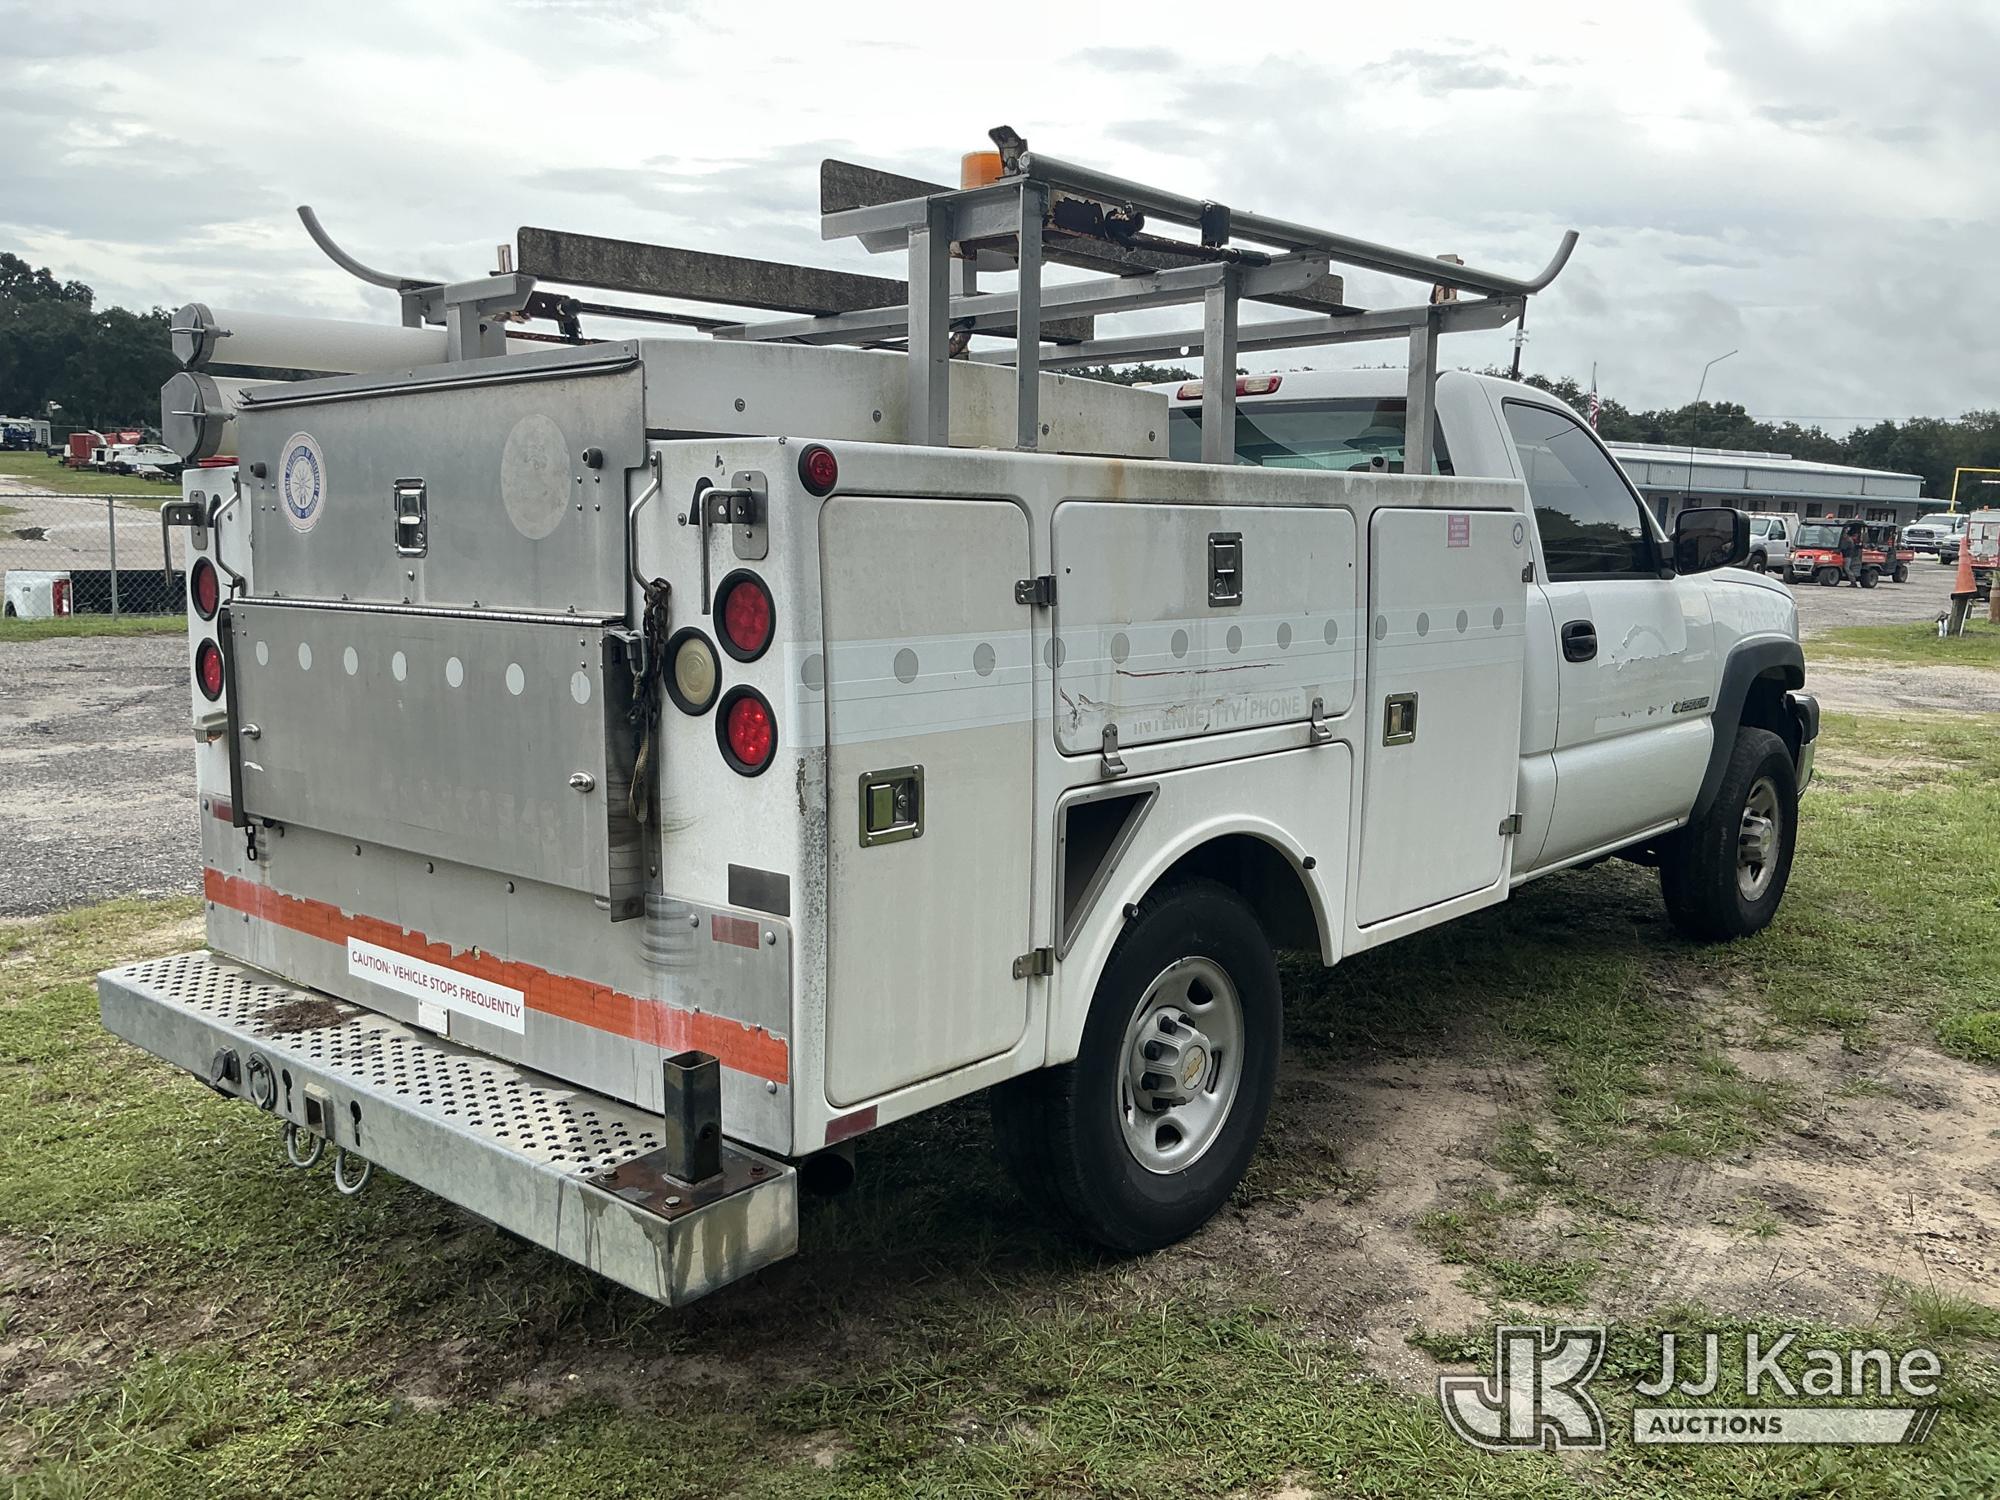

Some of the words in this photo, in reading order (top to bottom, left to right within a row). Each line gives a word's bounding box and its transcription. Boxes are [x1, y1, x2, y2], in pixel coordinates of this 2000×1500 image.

[1250, 695, 1300, 720] PHONE
[352, 951, 391, 974] CAUTION:
[393, 965, 428, 987] VEHICLE
[430, 977, 458, 998] STOPS
[460, 987, 521, 1019] FREQUENTLY
